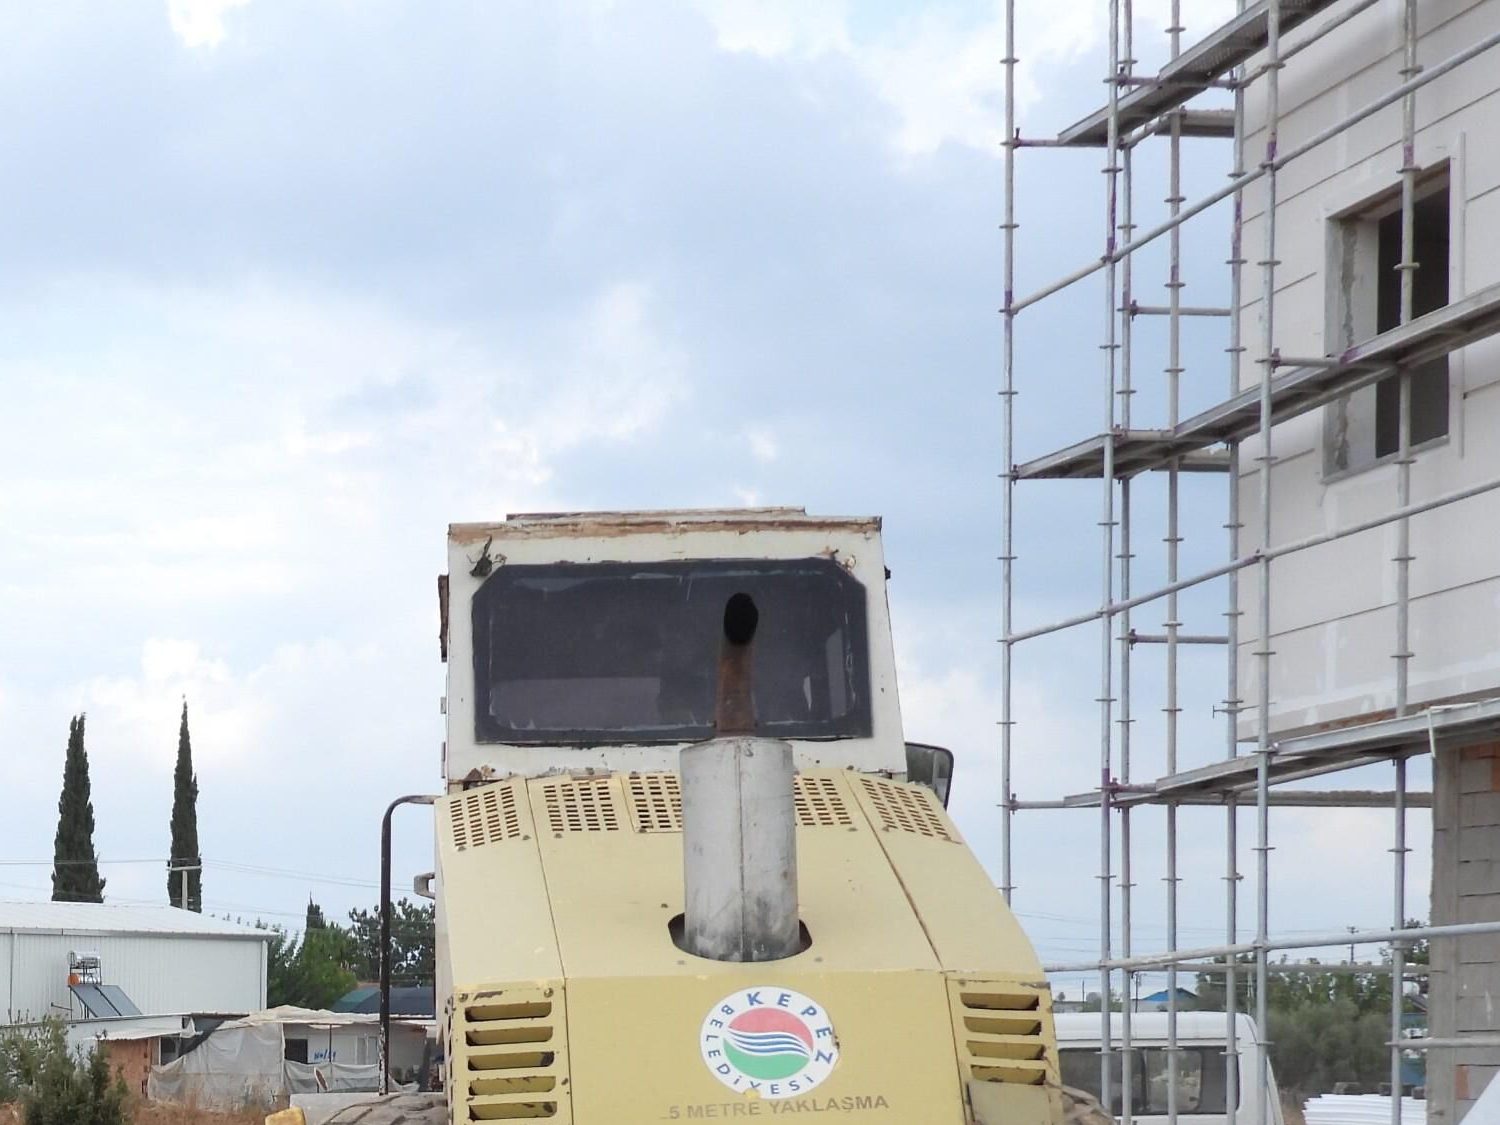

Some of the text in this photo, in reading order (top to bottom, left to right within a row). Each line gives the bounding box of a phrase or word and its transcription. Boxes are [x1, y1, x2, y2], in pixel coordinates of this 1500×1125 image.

[746, 991, 833, 1065] KEPEZ
[687, 1101, 762, 1118] METRE
[769, 1095, 889, 1115] YAKLAŞMA
